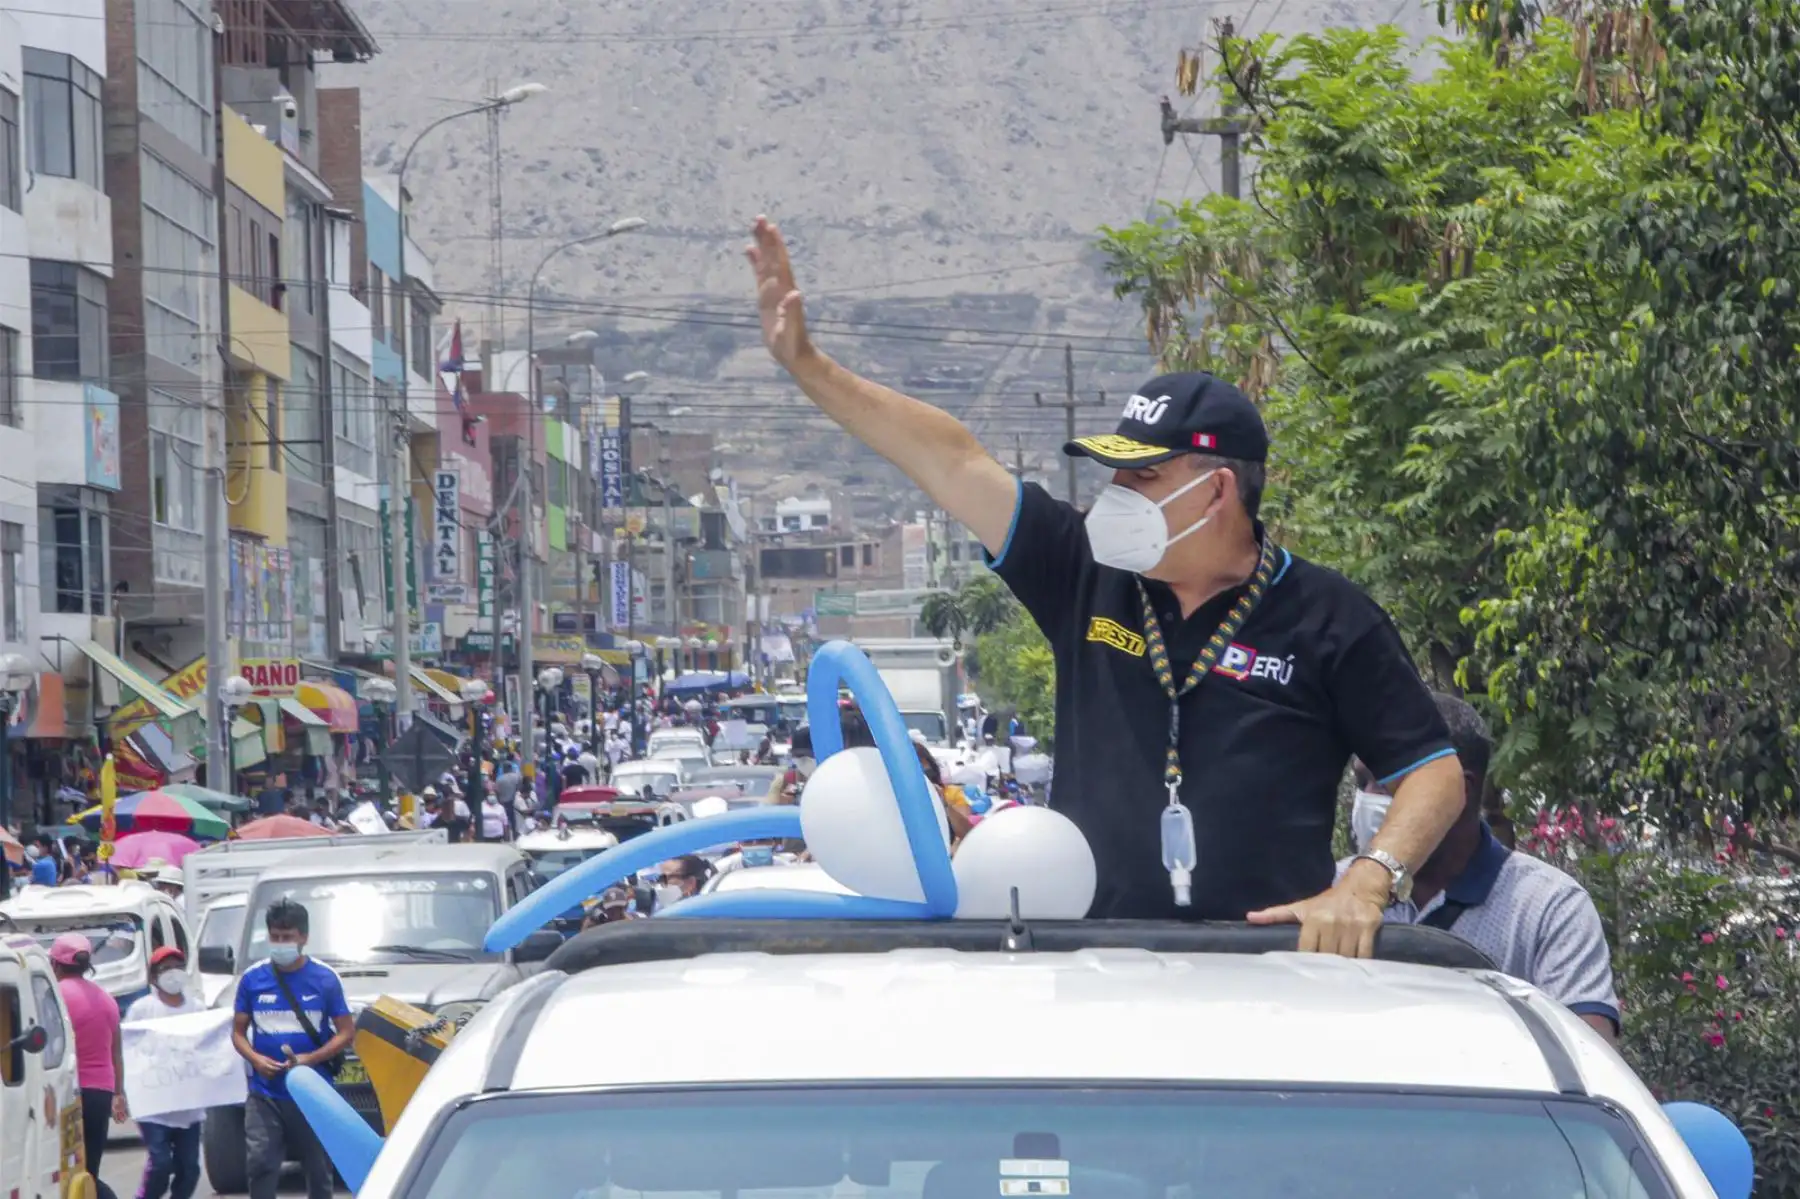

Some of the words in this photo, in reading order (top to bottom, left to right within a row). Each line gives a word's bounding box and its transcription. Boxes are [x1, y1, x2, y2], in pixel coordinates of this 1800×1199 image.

[603, 438, 621, 507] HOSTAL
[437, 473, 457, 574] DENTAL
[241, 660, 297, 686] BAÑO
[1221, 646, 1296, 686] PERÚ
